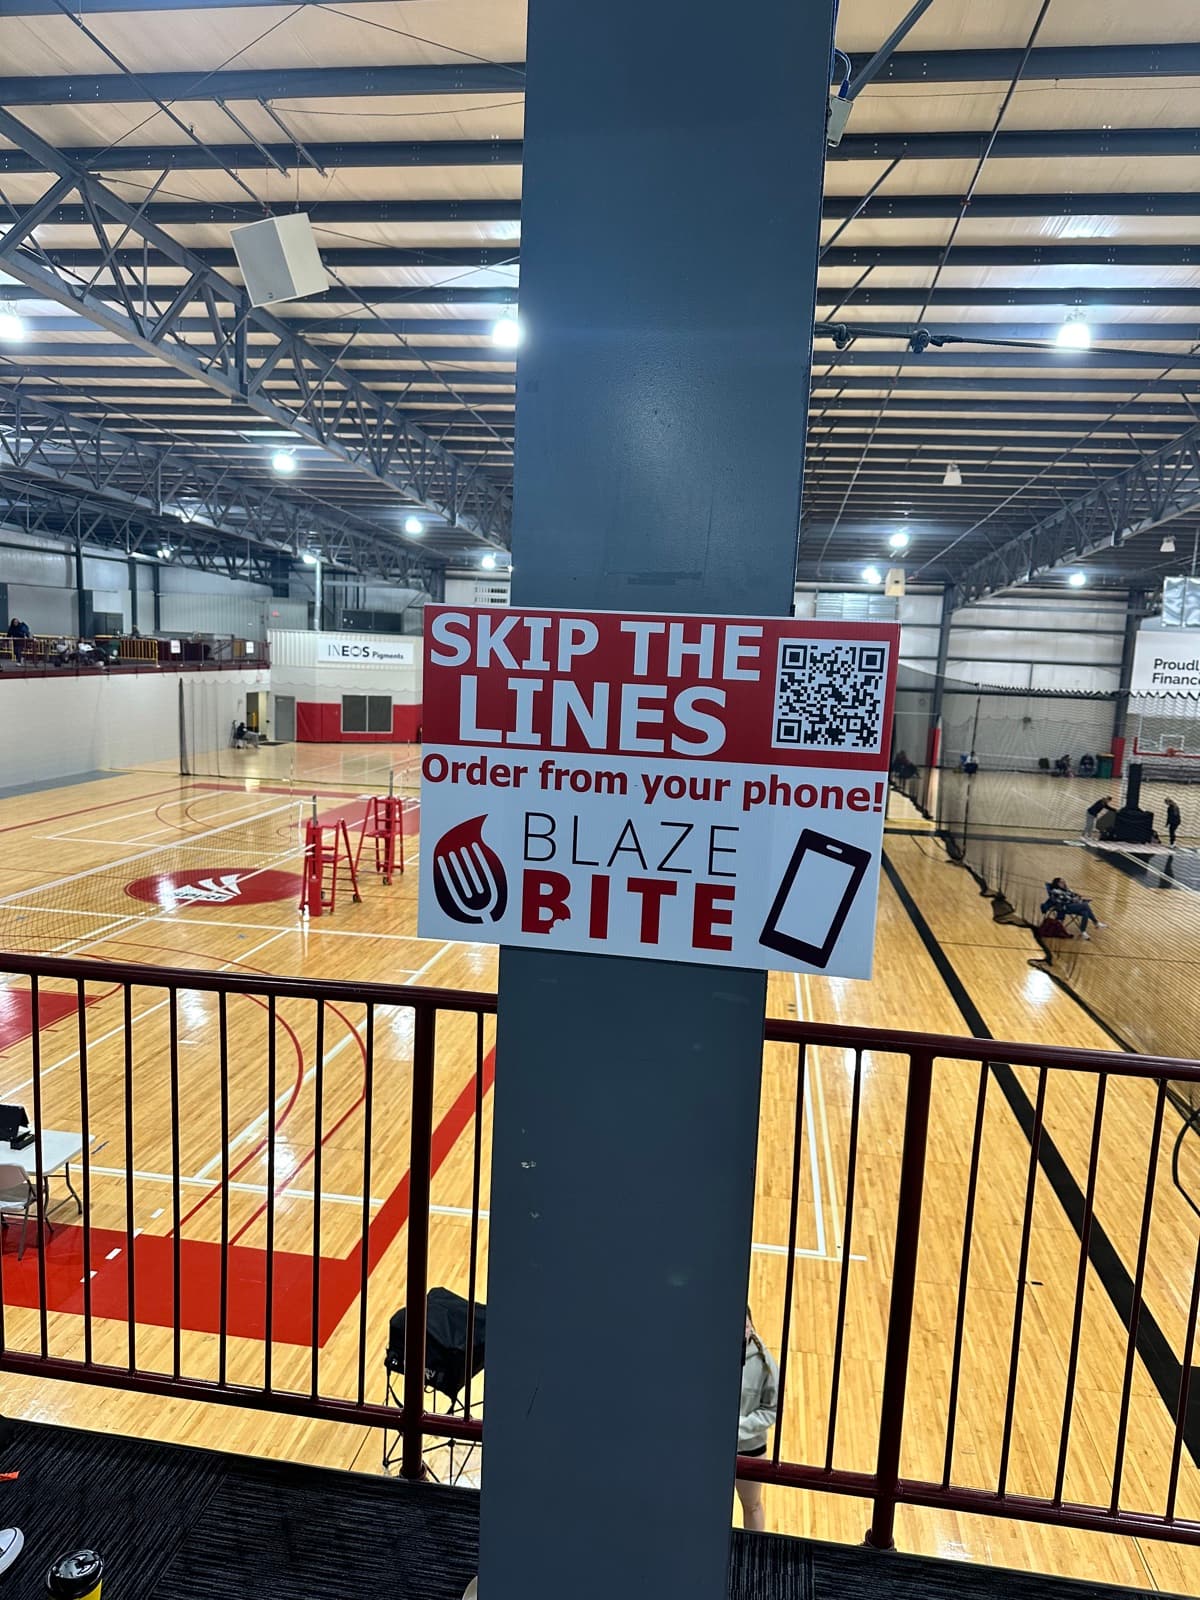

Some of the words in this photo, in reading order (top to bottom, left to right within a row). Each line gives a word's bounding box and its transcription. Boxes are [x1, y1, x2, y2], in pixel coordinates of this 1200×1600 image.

[328, 644, 370, 657] INEOS
[372, 651, 404, 660] Pigments
[430, 612, 599, 672] SKIP
[620, 620, 763, 681] THE
[1154, 658, 1200, 673] Proudl
[1152, 672, 1200, 685] Financ
[459, 674, 727, 757] LINES
[421, 753, 529, 788] Order
[539, 760, 628, 795] from
[640, 773, 731, 805] your
[742, 774, 885, 813] phone!
[523, 811, 740, 878] BLAZE
[521, 868, 736, 952] BITE
